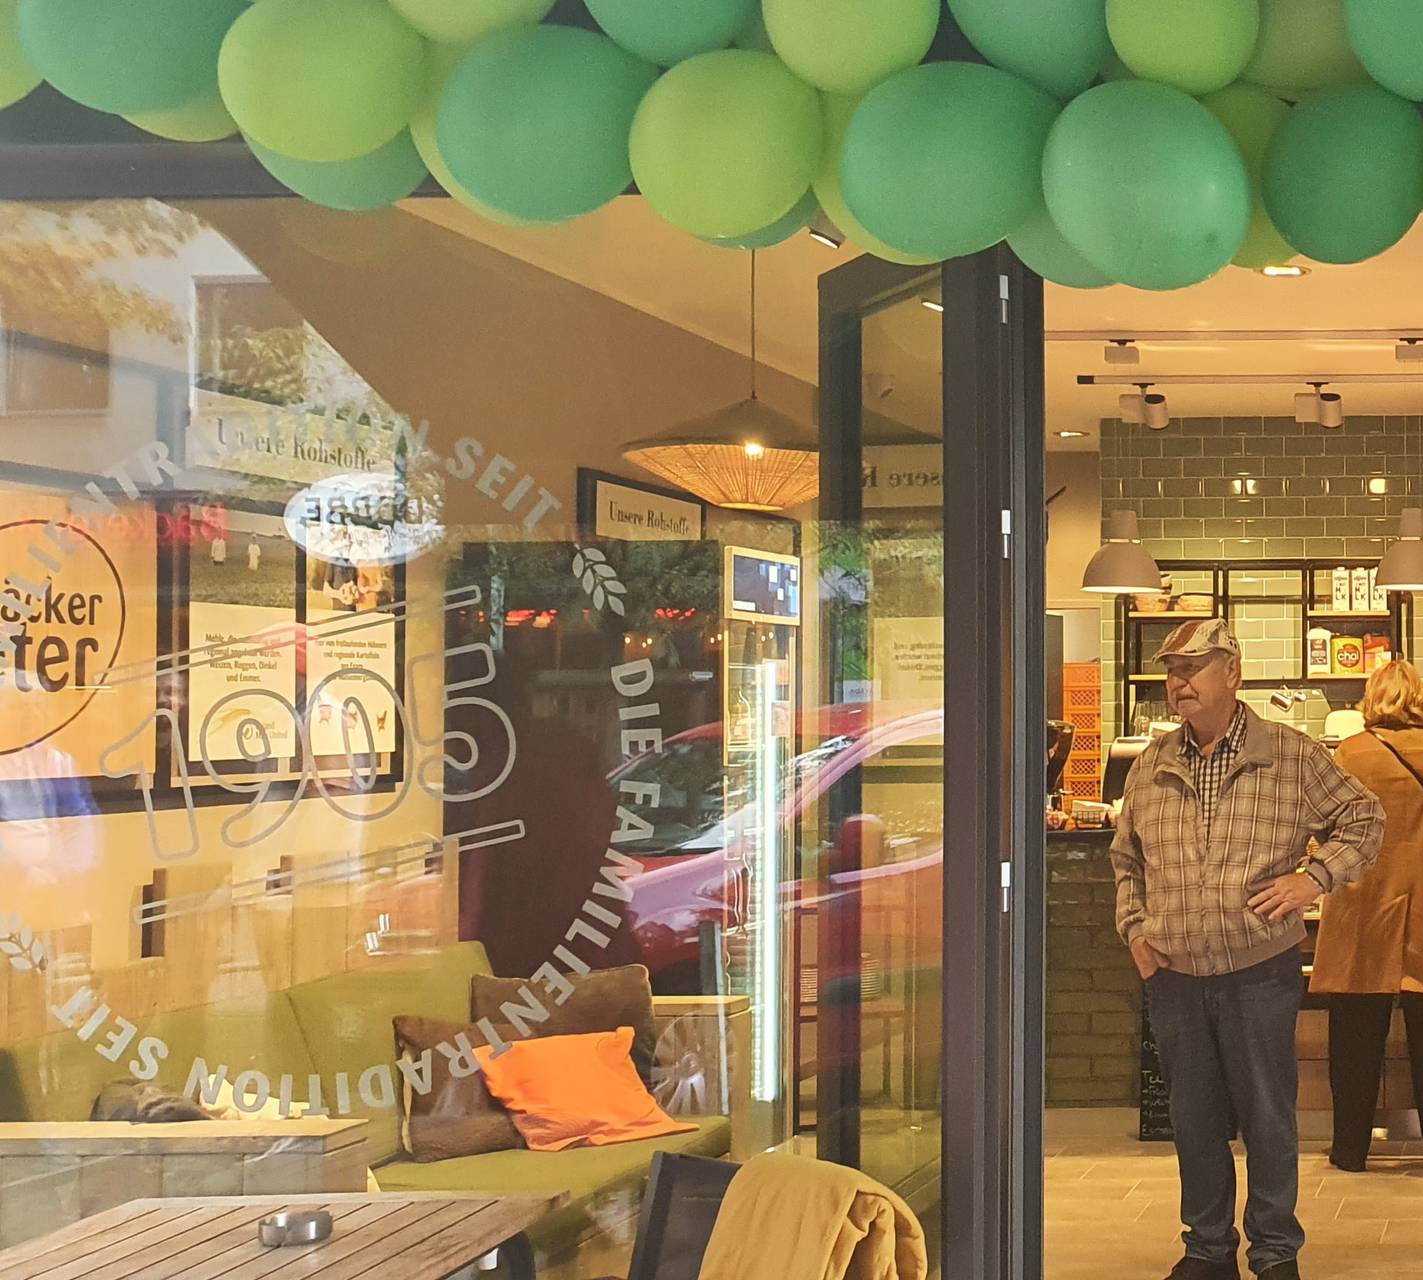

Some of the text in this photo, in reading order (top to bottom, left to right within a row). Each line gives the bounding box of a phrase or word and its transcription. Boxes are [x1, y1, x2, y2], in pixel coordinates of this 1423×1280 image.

[446, 436, 562, 532] SEIT
[609, 500, 689, 535] Unsere Rohstoffe
[99, 642, 517, 862] 1905
[51, 657, 663, 1117] DIE FAMILIENTRADITION SEIT
